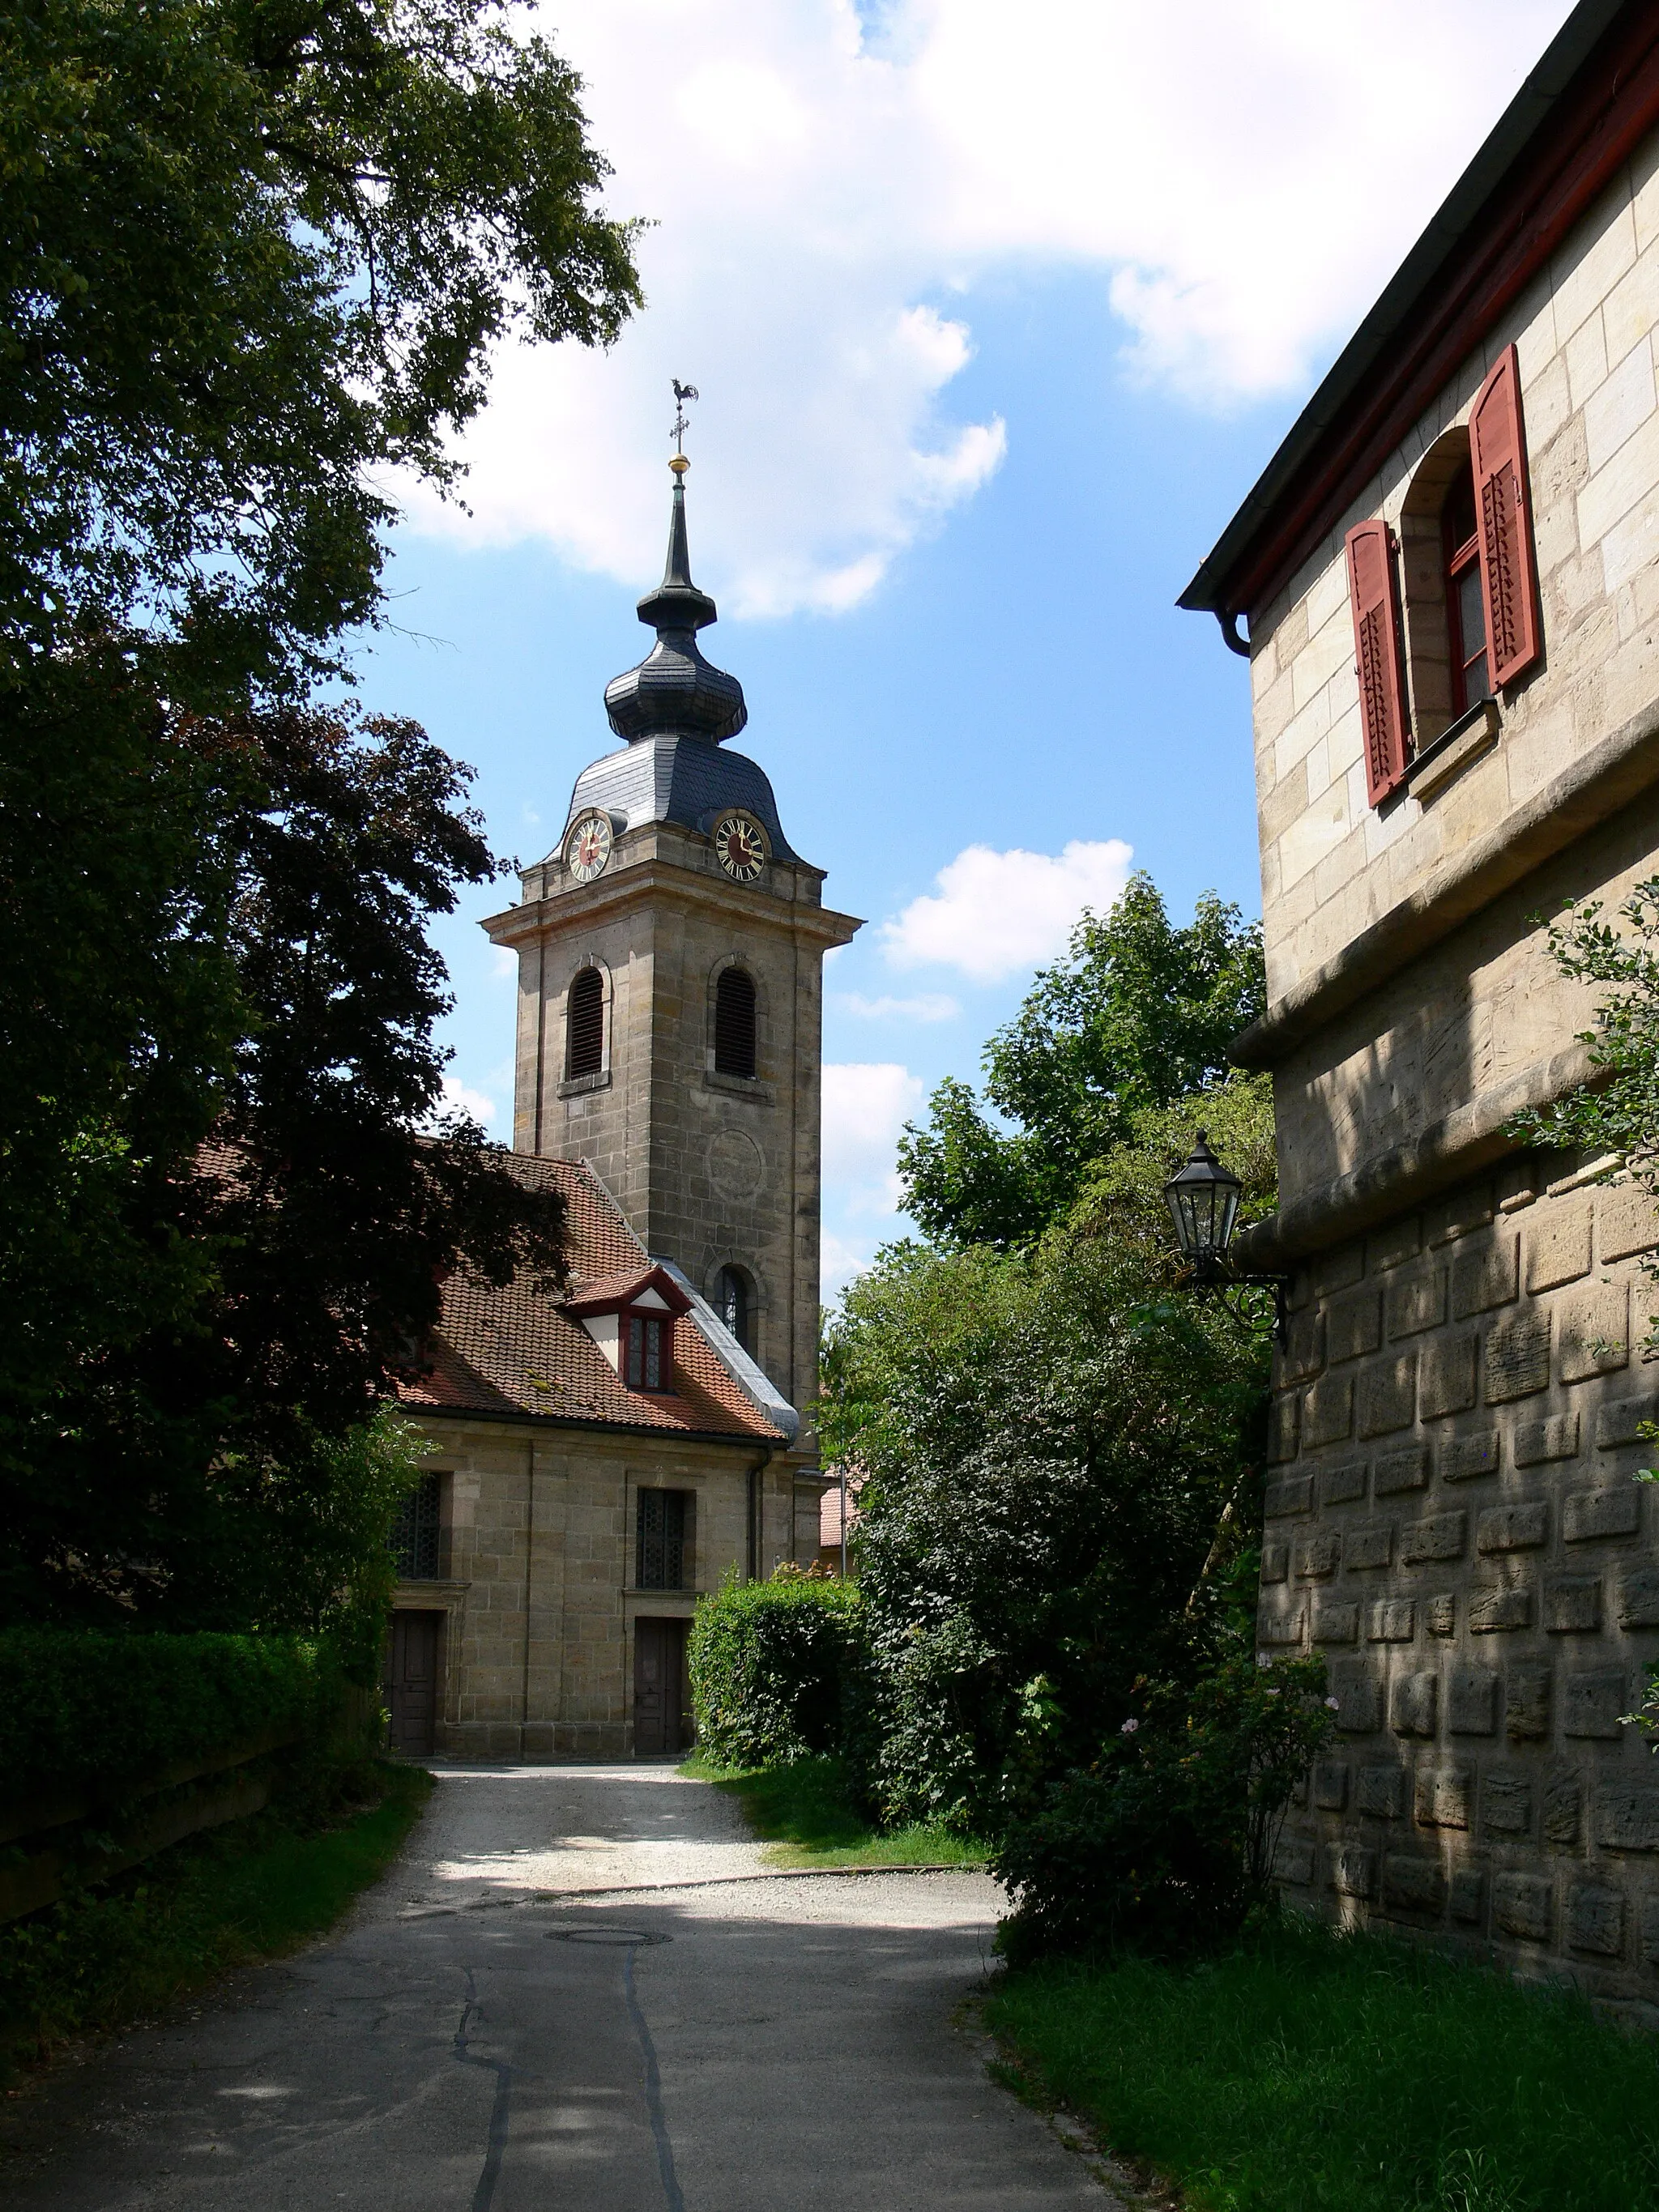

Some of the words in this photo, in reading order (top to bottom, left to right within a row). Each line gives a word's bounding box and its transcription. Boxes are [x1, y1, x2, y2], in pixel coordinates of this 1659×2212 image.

[727, 820, 736, 834] XI
[719, 827, 730, 839] X
[746, 828, 753, 837] I
[717, 839, 727, 848] IX
